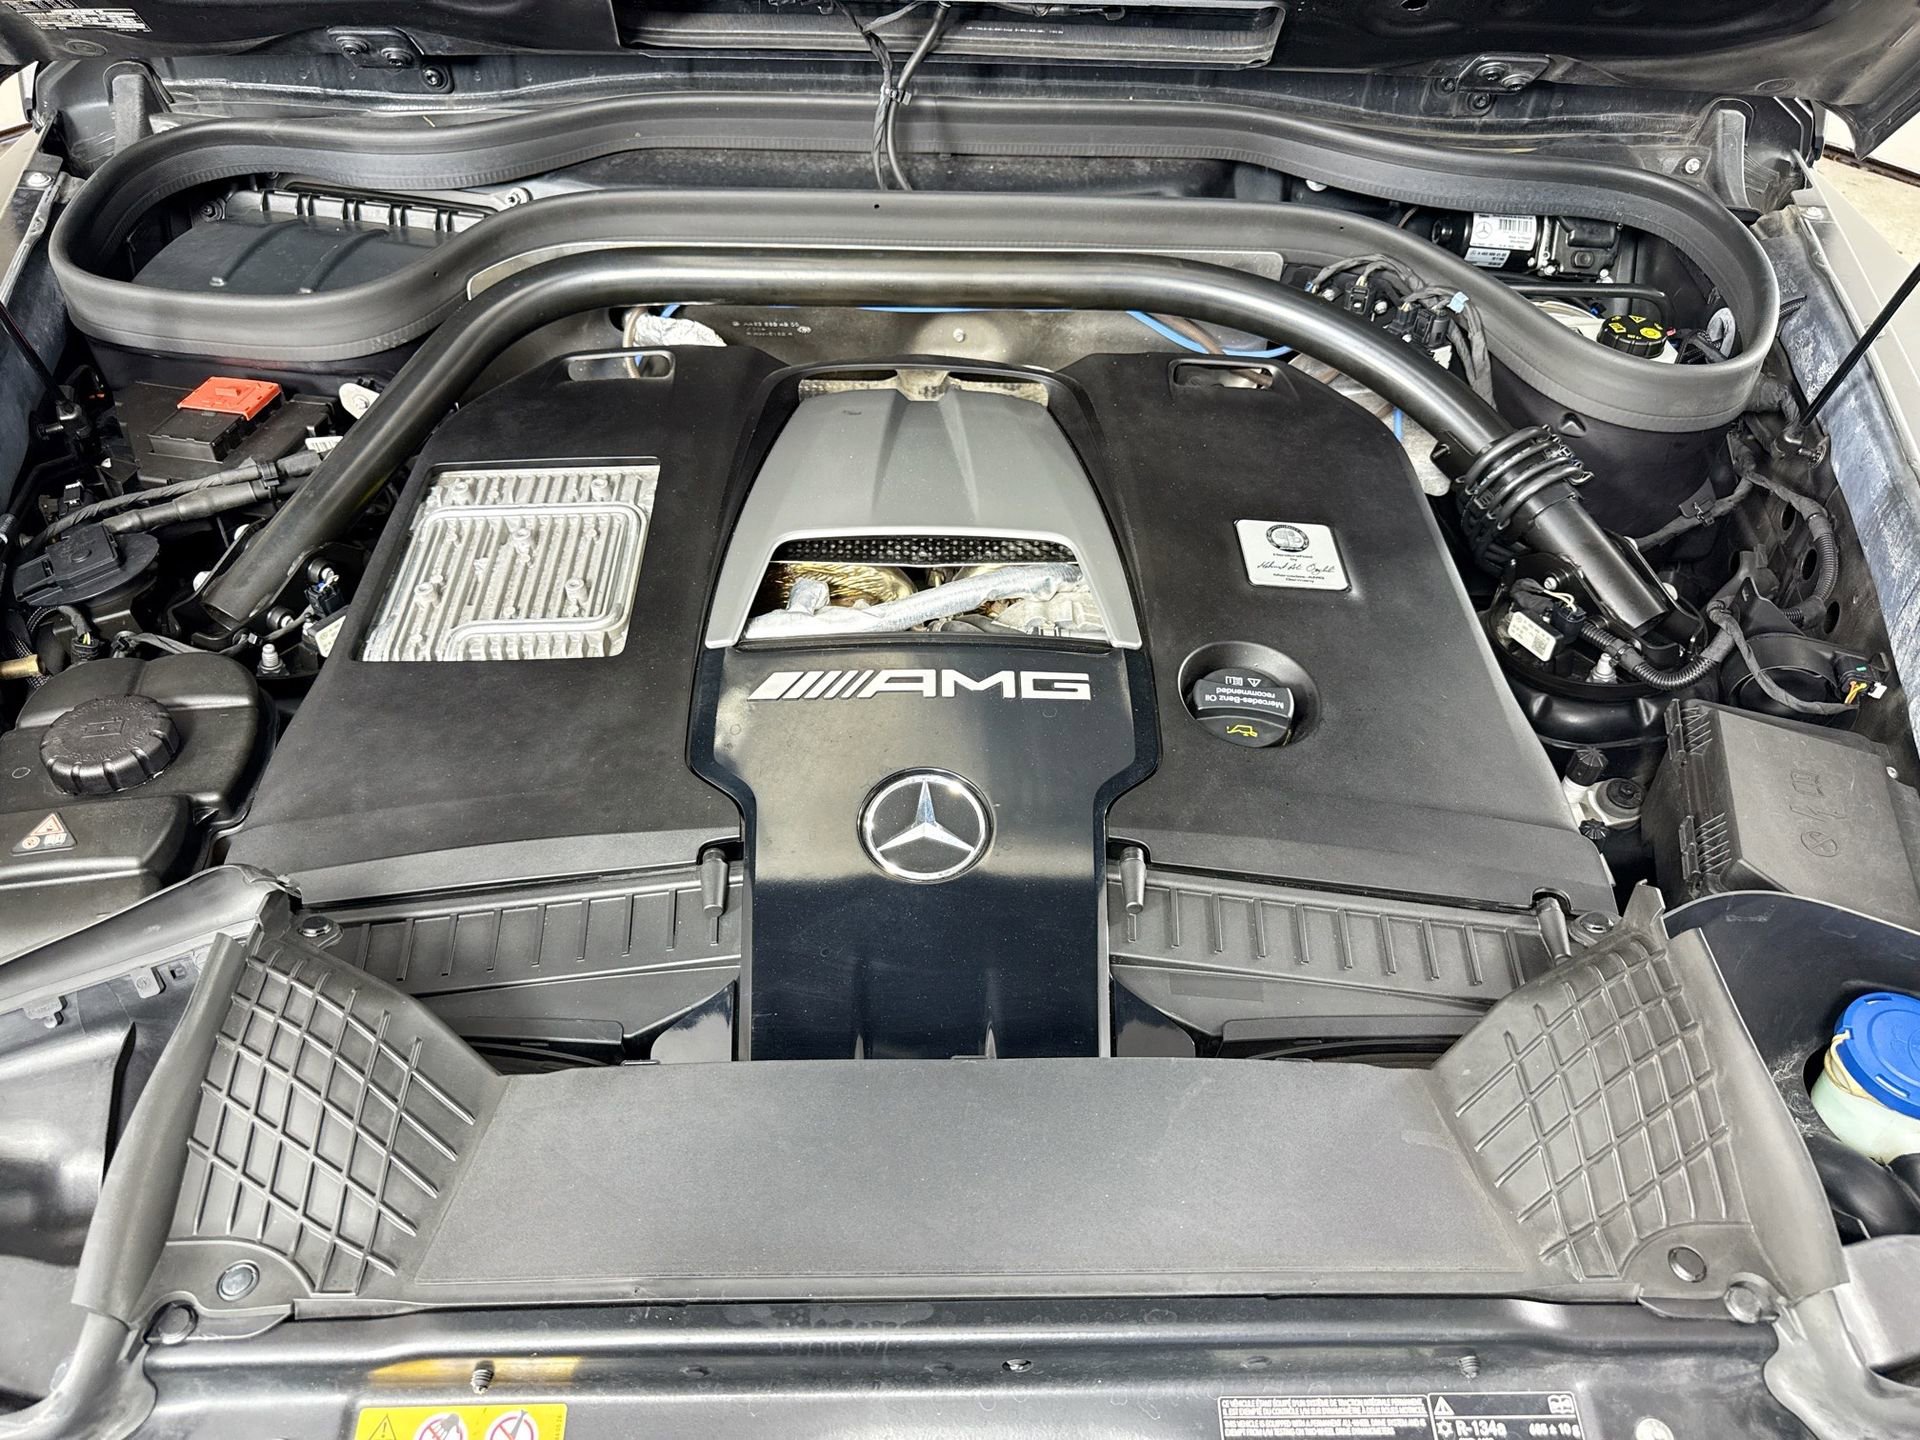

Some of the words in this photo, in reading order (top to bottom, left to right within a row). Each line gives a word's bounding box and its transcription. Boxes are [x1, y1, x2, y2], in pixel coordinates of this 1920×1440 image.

[857, 669, 1091, 700] AMG
[1205, 694, 1217, 702] Oil
[1216, 687, 1275, 698] recommended
[1219, 695, 1284, 709] Mercedes-Benz
[1455, 1420, 1507, 1437] R-134a
[1558, 1423, 1571, 1435] 10
